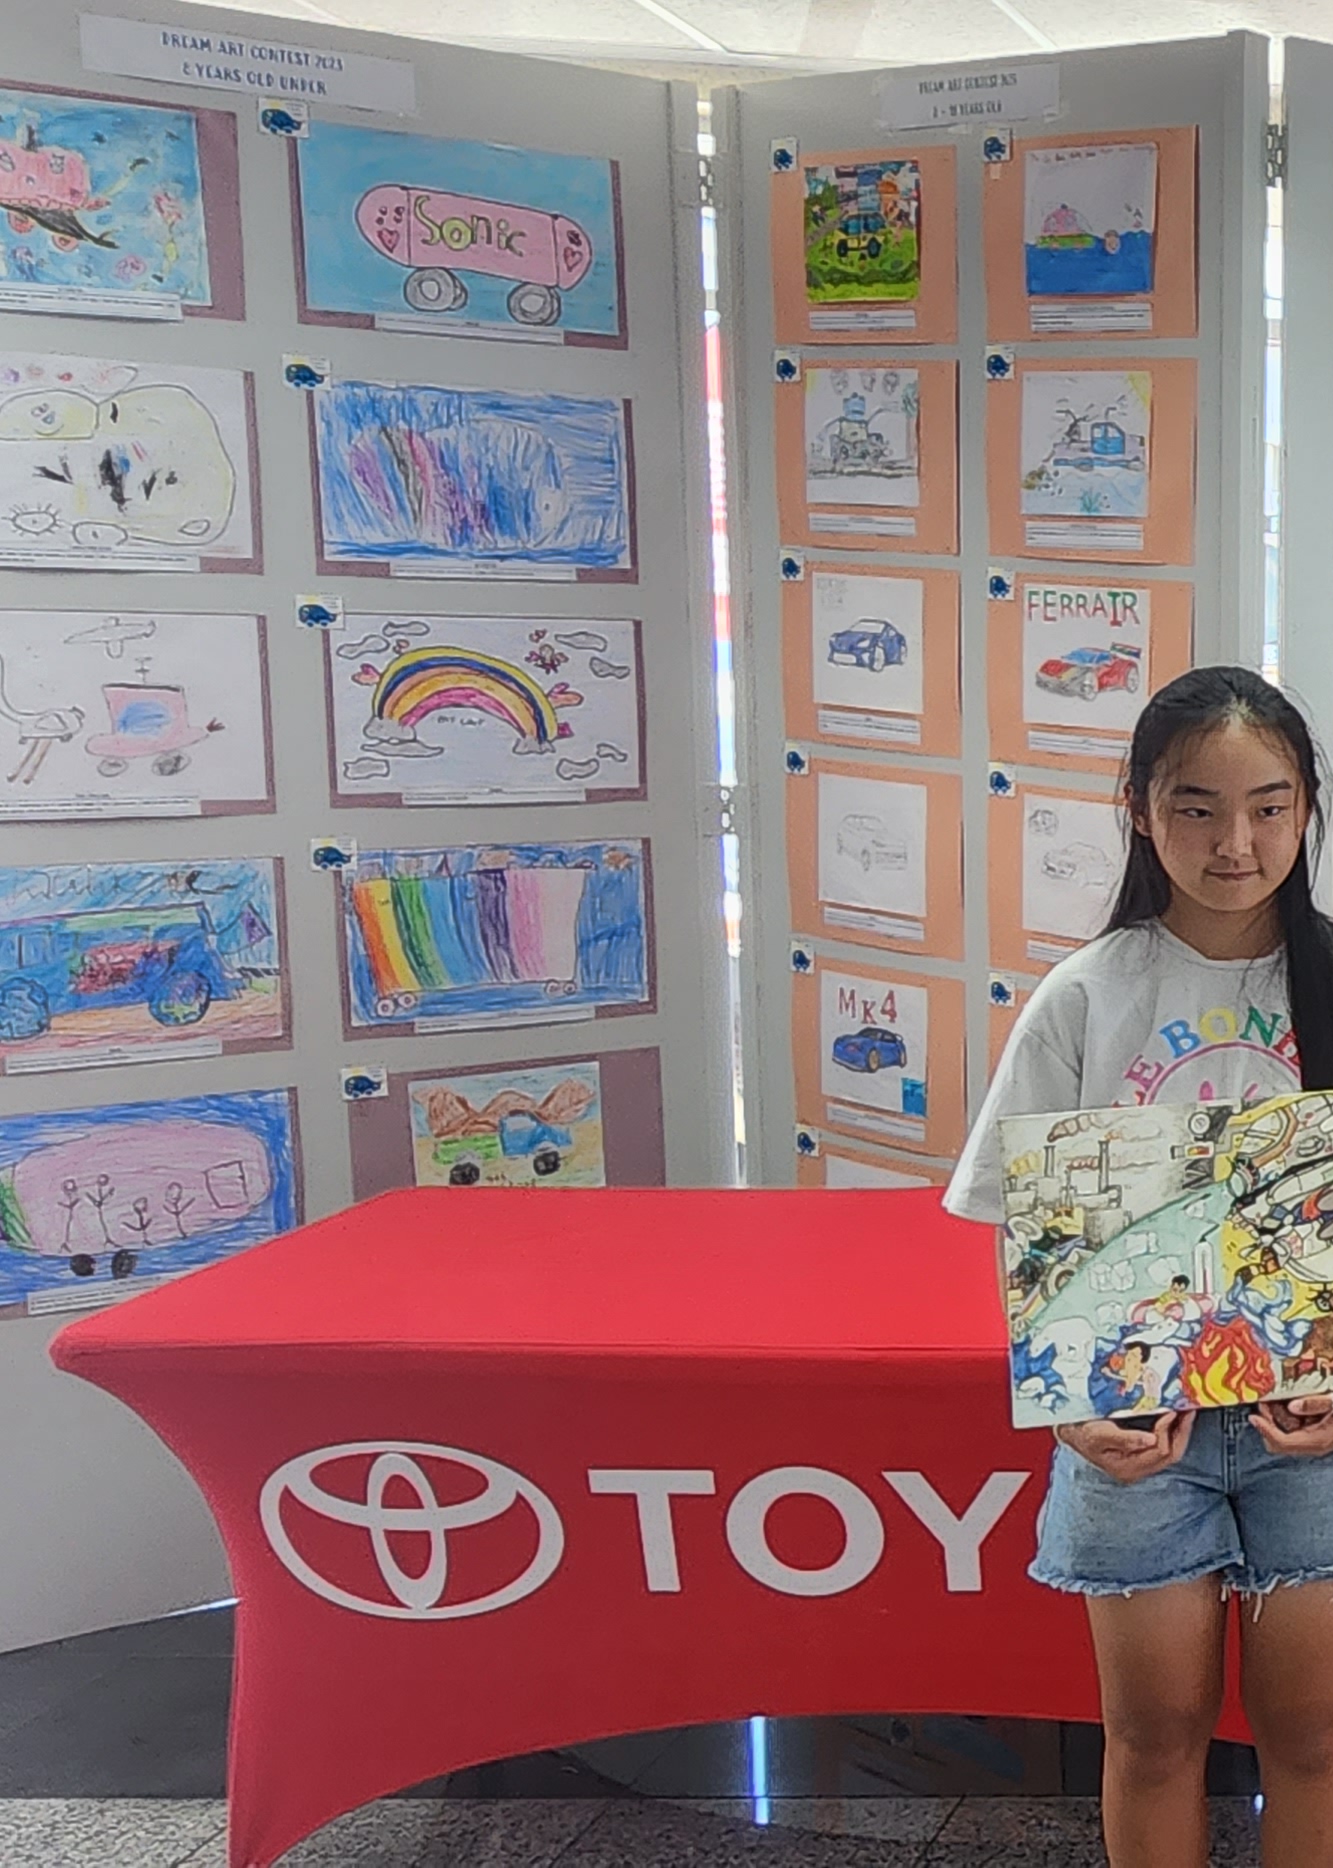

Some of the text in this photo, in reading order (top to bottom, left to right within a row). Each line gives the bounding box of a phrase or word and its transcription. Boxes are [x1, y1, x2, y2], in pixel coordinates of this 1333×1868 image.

[162, 31, 212, 53] DREAM
[218, 41, 245, 57] ART
[250, 45, 311, 67] CONTEST
[196, 63, 242, 83] YEARS
[246, 71, 275, 88] OLD
[279, 76, 327, 96] UNDER
[413, 195, 527, 257] Sonic
[1027, 589, 1141, 628] FERRAIR
